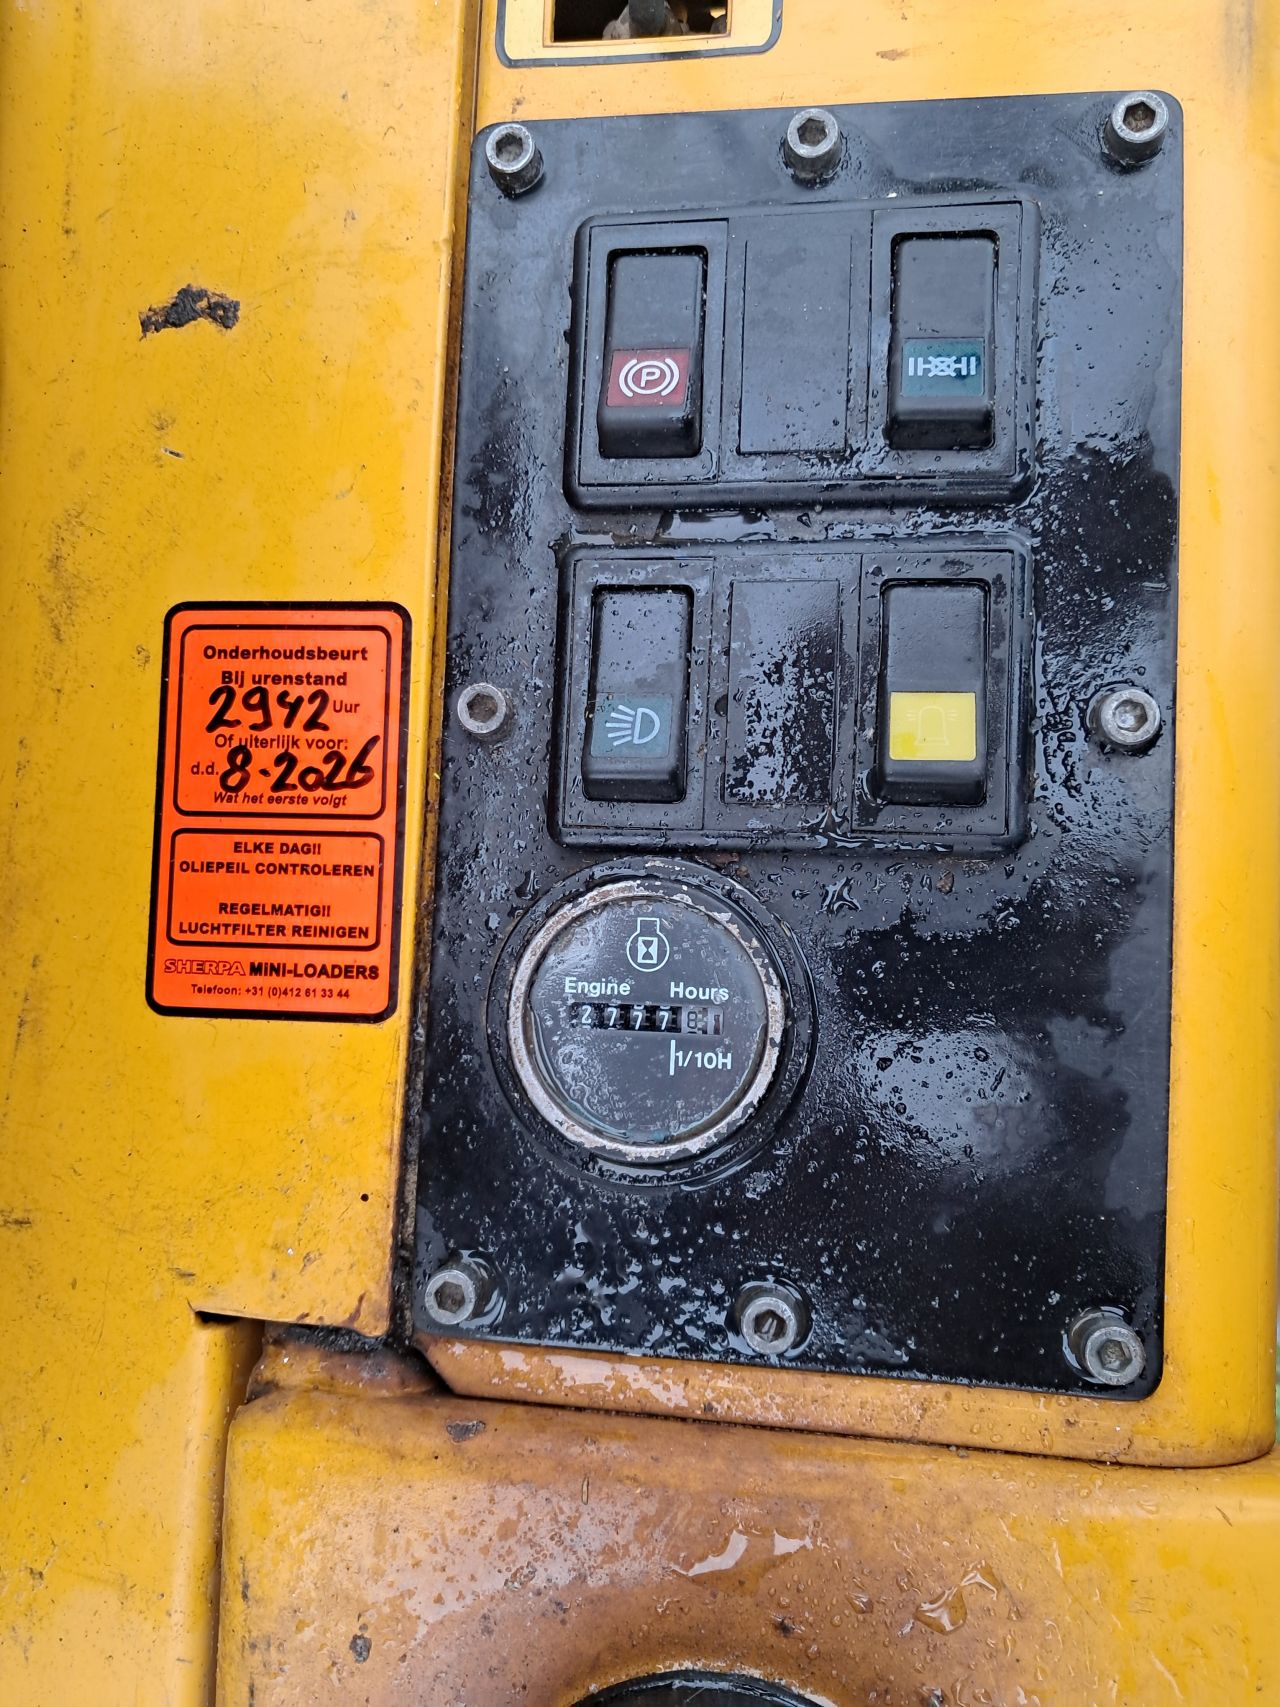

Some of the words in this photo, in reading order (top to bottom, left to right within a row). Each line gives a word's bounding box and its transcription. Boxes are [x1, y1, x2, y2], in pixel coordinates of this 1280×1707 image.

[640, 367, 660, 387] P
[203, 645, 368, 661] Onderhoudsbeurt
[252, 672, 347, 686] urenstand
[206, 685, 330, 733] 2942
[333, 701, 360, 713] Uur
[214, 734, 234, 748] Of
[239, 734, 300, 750] uiterlijk
[190, 762, 219, 775] d.d.
[213, 792, 239, 804] Wat
[242, 793, 264, 804] het
[267, 794, 308, 805] eerste
[313, 795, 347, 808] volgt
[233, 842, 274, 854] ELKE
[279, 843, 321, 855] DAG!!
[179, 861, 250, 874] OLIEPEIL
[255, 863, 375, 877] CONTROLEREN
[218, 903, 331, 917] REGELMATIG!!
[179, 922, 286, 936] LUCHTFILTER
[291, 925, 369, 939] REINIGEN
[164, 959, 246, 976] SHERPA
[249, 962, 380, 980] MINI-LOADERS
[191, 984, 241, 995] Telefoon:
[245, 986, 263, 996] +31
[268, 986, 301, 998] (0)412
[305, 988, 317, 998] 61
[321, 988, 333, 998] 33
[337, 989, 350, 998] 44
[564, 976, 631, 998] Engine
[670, 982, 730, 1001] Hours
